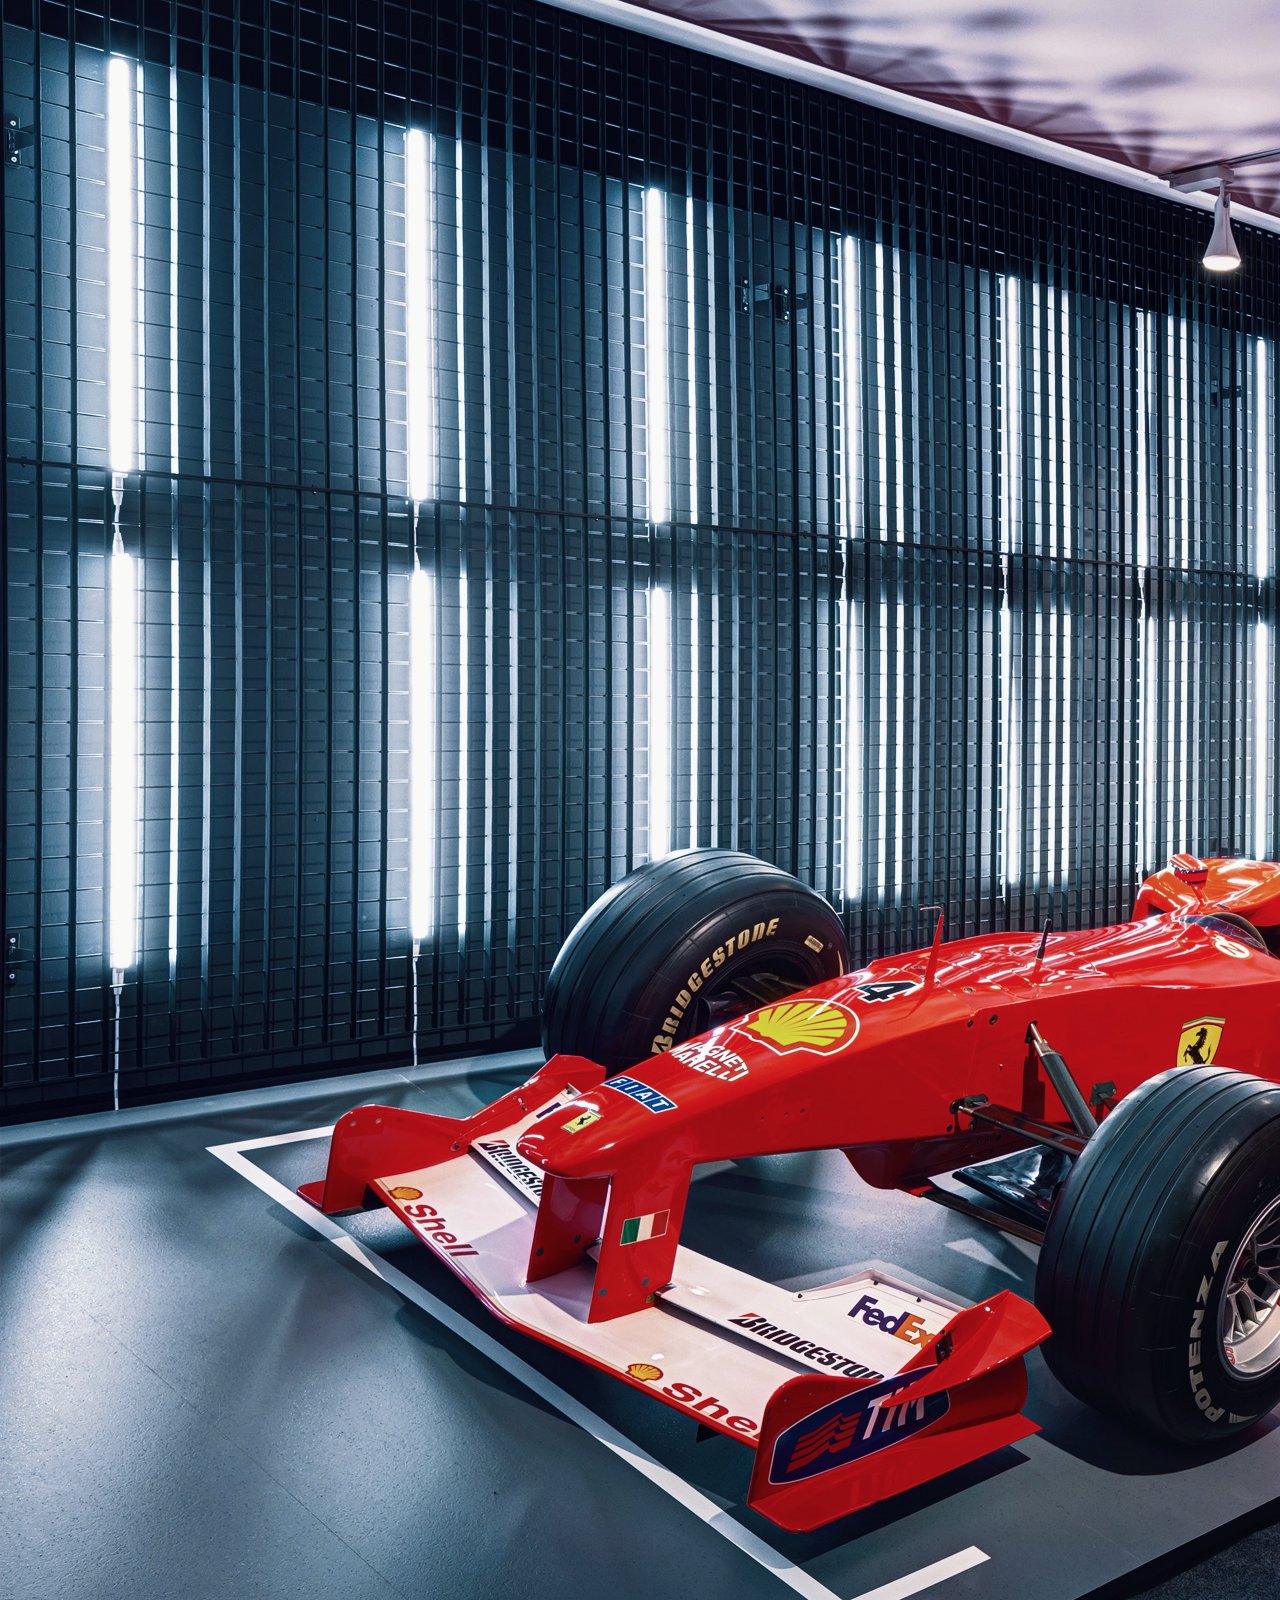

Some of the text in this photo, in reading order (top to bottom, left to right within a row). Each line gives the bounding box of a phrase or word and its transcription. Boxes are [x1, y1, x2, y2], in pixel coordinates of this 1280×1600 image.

[652, 917, 782, 1054] BRIDGESTONE
[857, 979, 919, 1003] 4
[669, 1045, 749, 1082] MARELLI
[609, 1078, 670, 1108] FIAT
[404, 1204, 480, 1257] Shell
[727, 1312, 885, 1380] BRIDGESTON
[848, 1294, 937, 1349] FedEx
[1188, 1239, 1229, 1423] POTENZA
[662, 1382, 760, 1441] She
